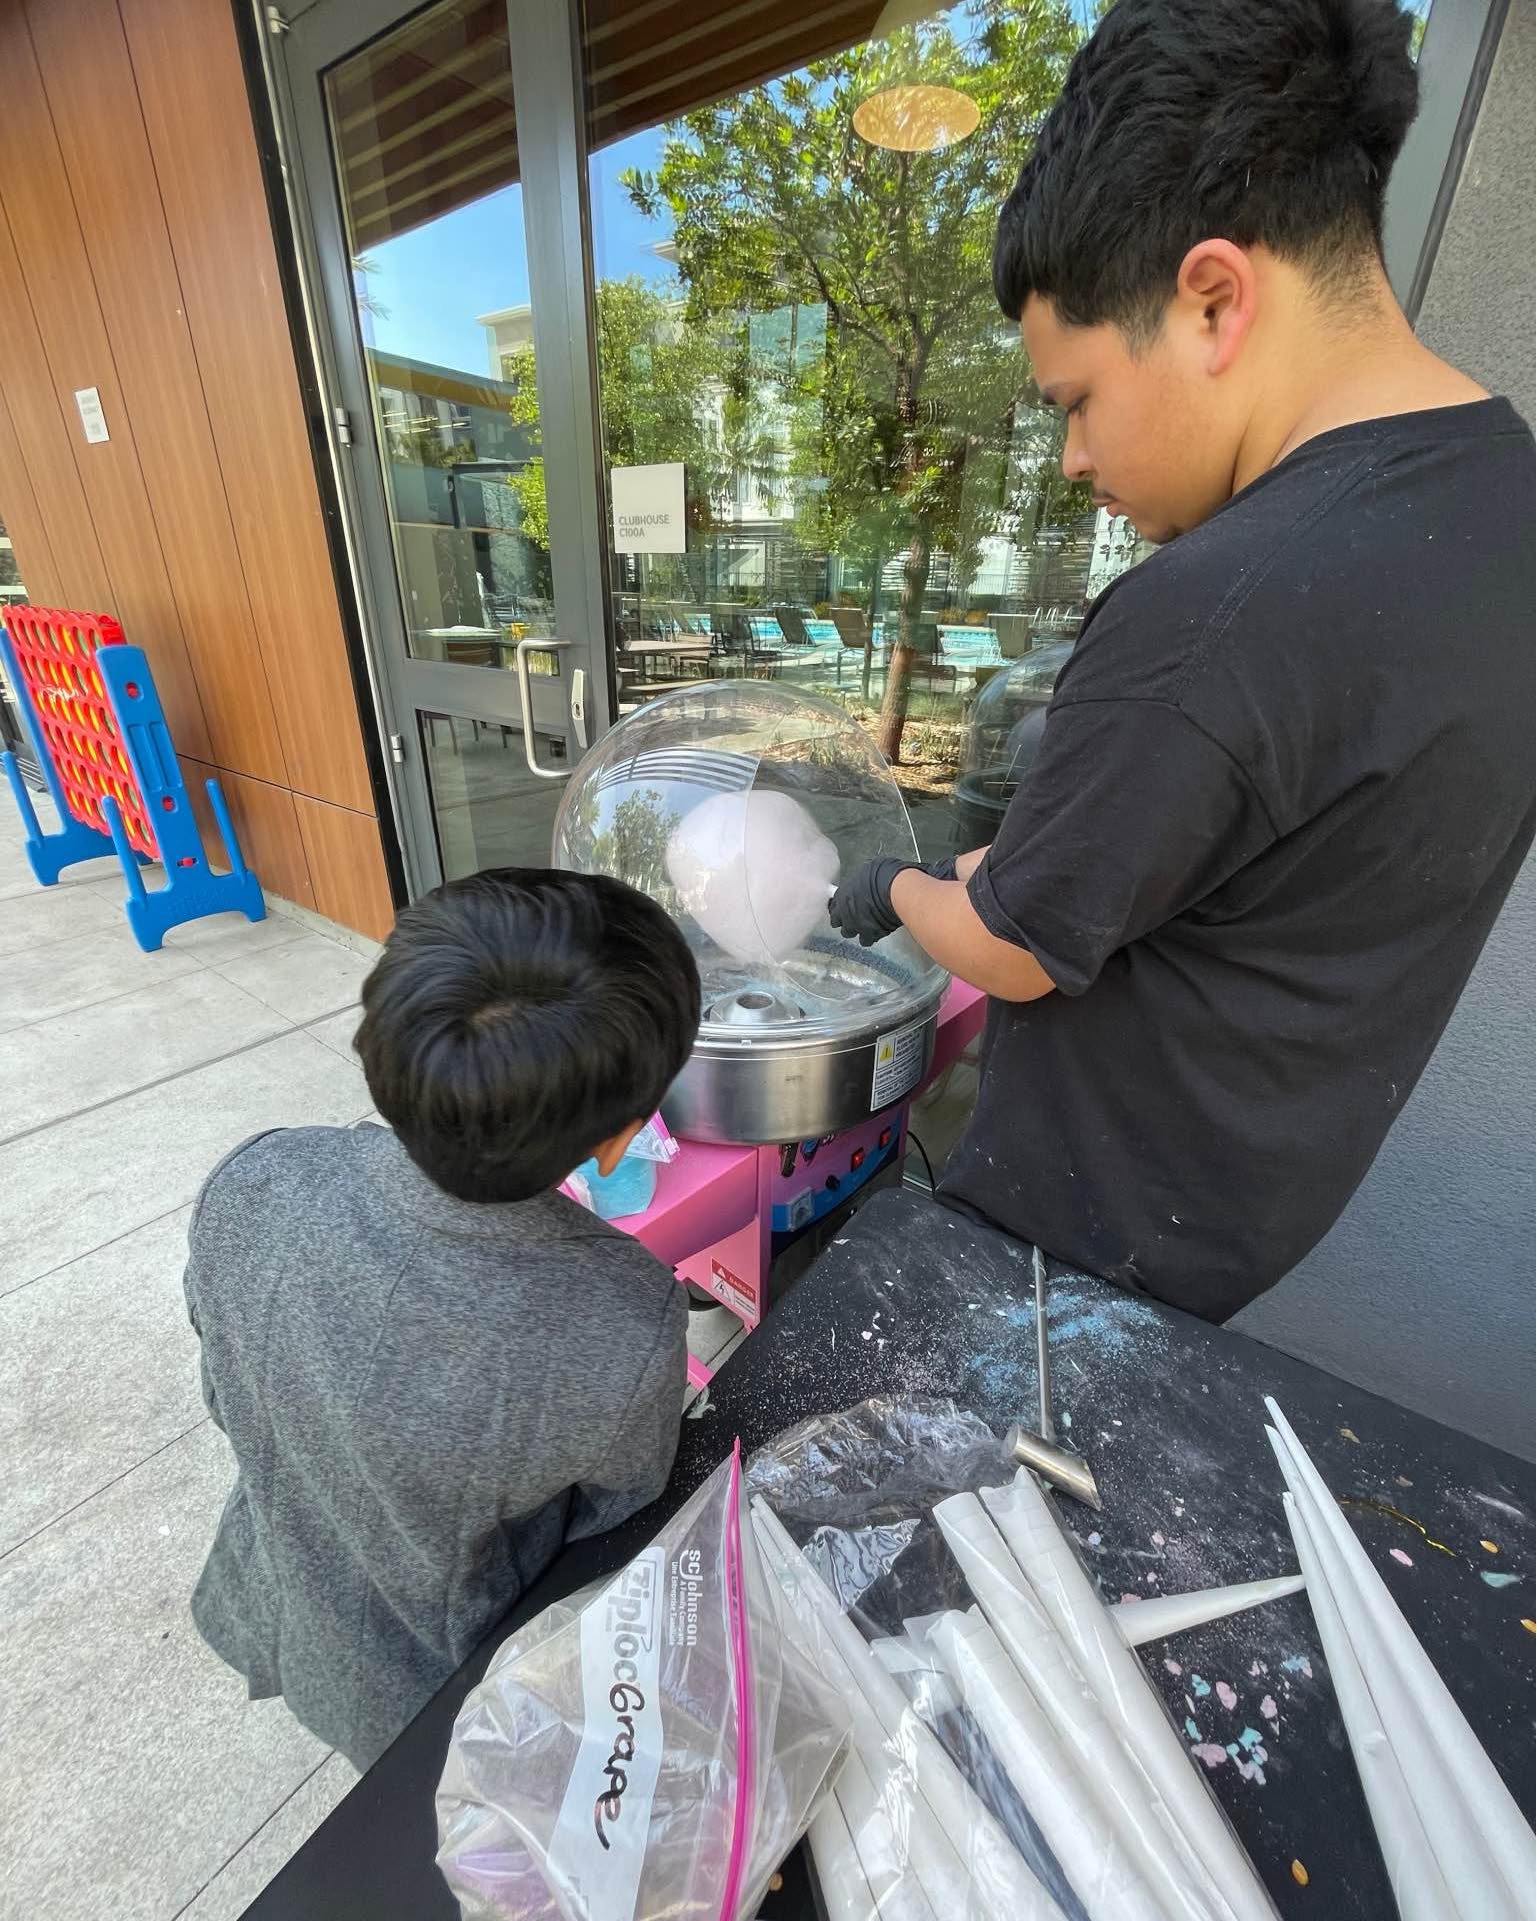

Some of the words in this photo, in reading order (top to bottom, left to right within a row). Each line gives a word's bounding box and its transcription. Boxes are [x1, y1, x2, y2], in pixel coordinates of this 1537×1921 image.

[618, 514, 670, 526] CLUBHOUSE
[619, 528, 645, 537] C100A
[594, 1683, 645, 1850] Grape
